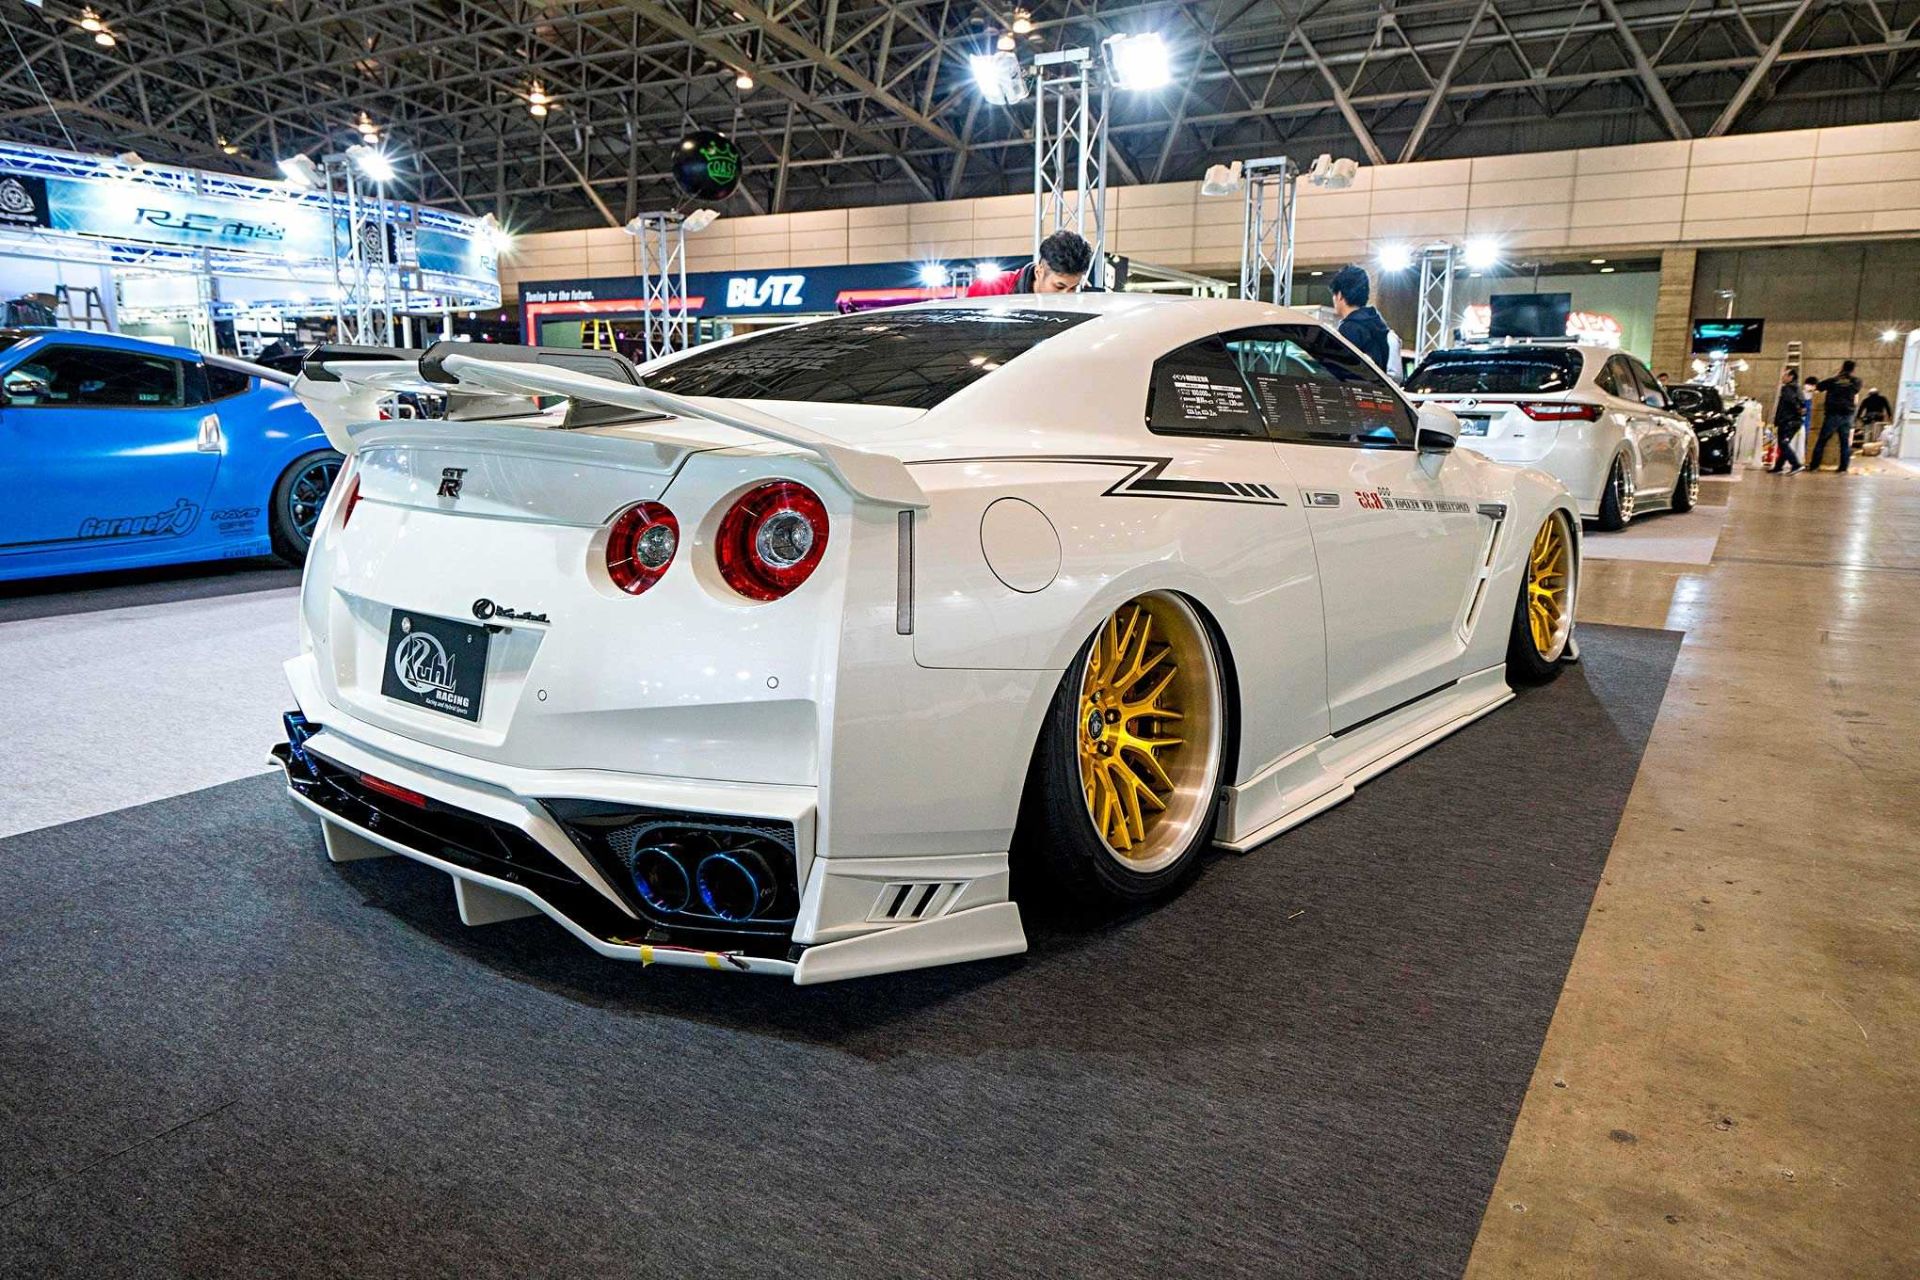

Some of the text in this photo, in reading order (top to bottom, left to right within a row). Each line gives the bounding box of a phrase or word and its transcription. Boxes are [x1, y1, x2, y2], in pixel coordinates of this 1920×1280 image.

[525, 289, 595, 304] Tuning for the future.
[726, 275, 806, 308] BLITZ
[442, 467, 469, 479] GT
[436, 478, 463, 500] R
[435, 690, 470, 708] RACING
